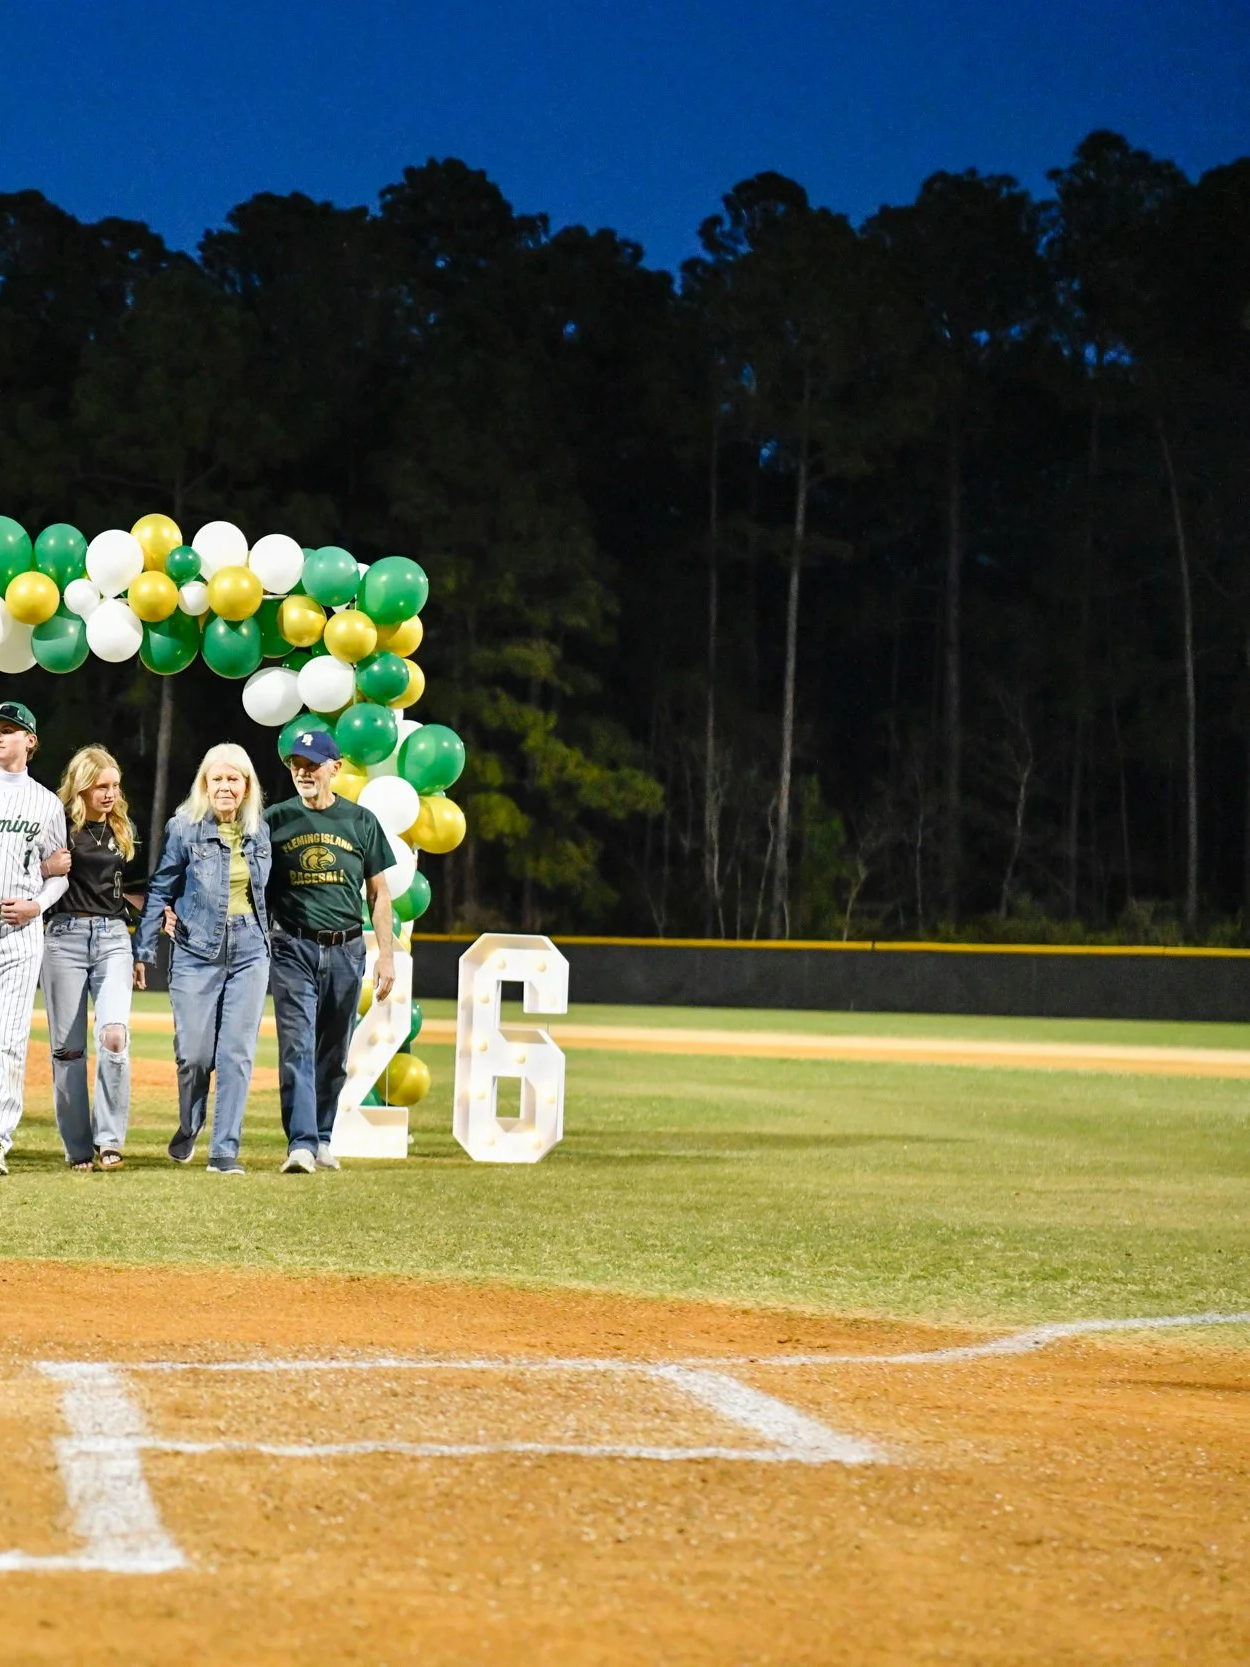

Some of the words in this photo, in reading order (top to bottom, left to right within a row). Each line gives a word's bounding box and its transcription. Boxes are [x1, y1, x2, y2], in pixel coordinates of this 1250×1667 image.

[282, 833, 320, 854] FLEMING
[23, 849, 32, 875] 1
[453, 932, 570, 1164] 6
